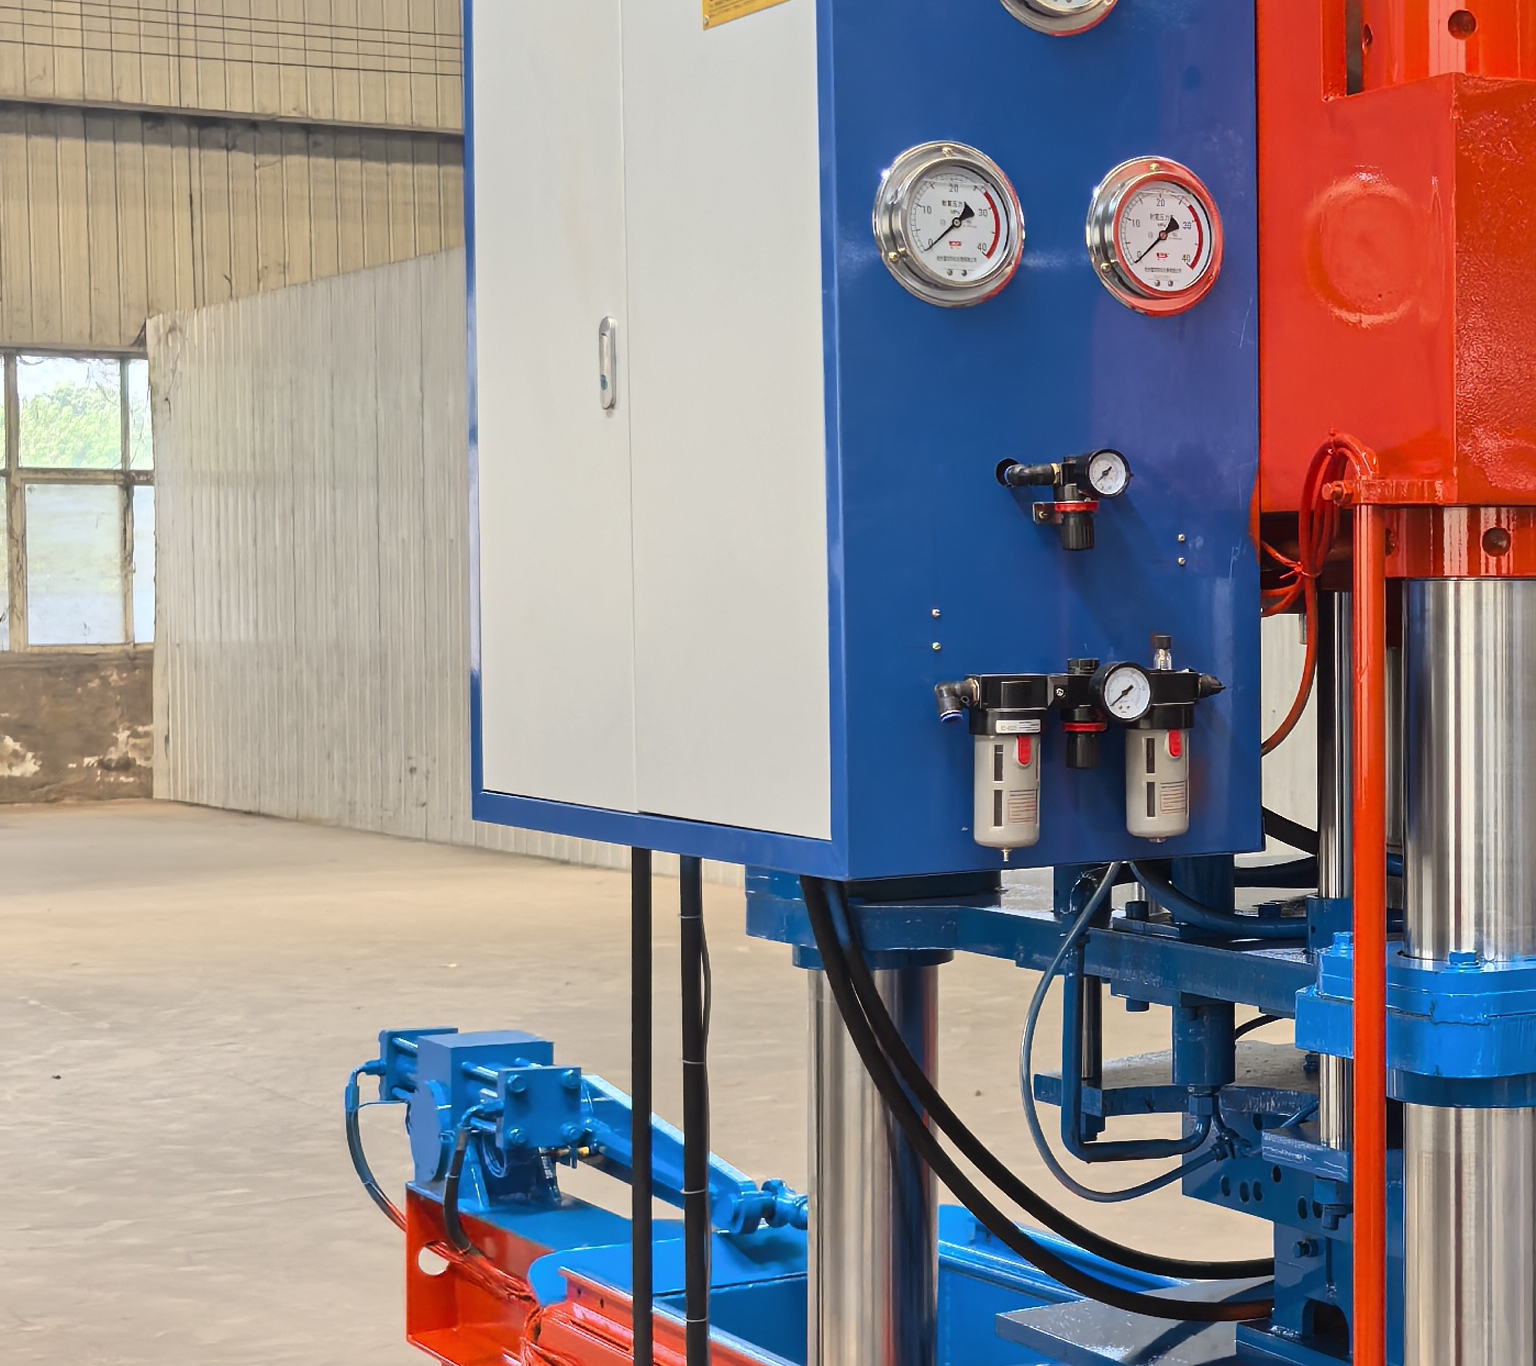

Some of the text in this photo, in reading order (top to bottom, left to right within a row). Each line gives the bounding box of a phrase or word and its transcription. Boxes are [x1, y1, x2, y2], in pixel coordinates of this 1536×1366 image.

[949, 183, 958, 193] 20
[1156, 198, 1165, 207] 20
[922, 205, 932, 214] 10
[978, 208, 988, 217] 30
[1132, 219, 1141, 227] 10
[1182, 221, 1191, 230] 30
[928, 238, 933, 246] 0
[977, 242, 987, 251] 40
[1181, 254, 1191, 263] 40
